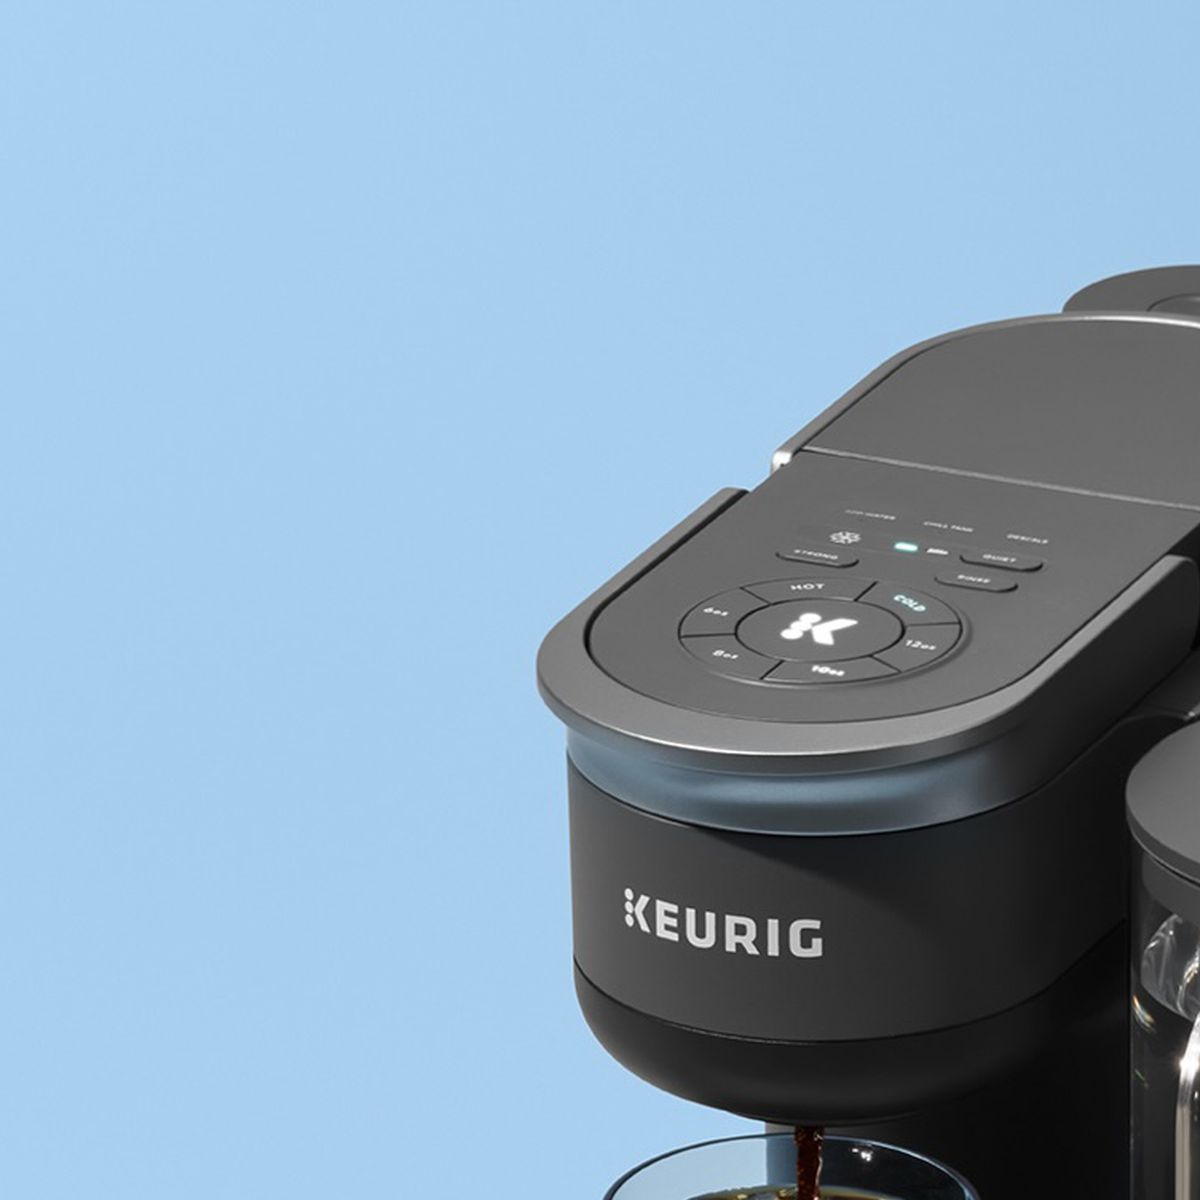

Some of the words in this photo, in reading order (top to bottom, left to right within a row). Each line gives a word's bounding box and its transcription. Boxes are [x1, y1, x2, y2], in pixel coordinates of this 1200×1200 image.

[793, 549, 838, 560] STRONG
[790, 583, 825, 591] HOT
[893, 594, 926, 612] COLD
[905, 640, 936, 651] 12oz
[811, 665, 845, 677] 10oz
[624, 888, 823, 958] KEURIG
